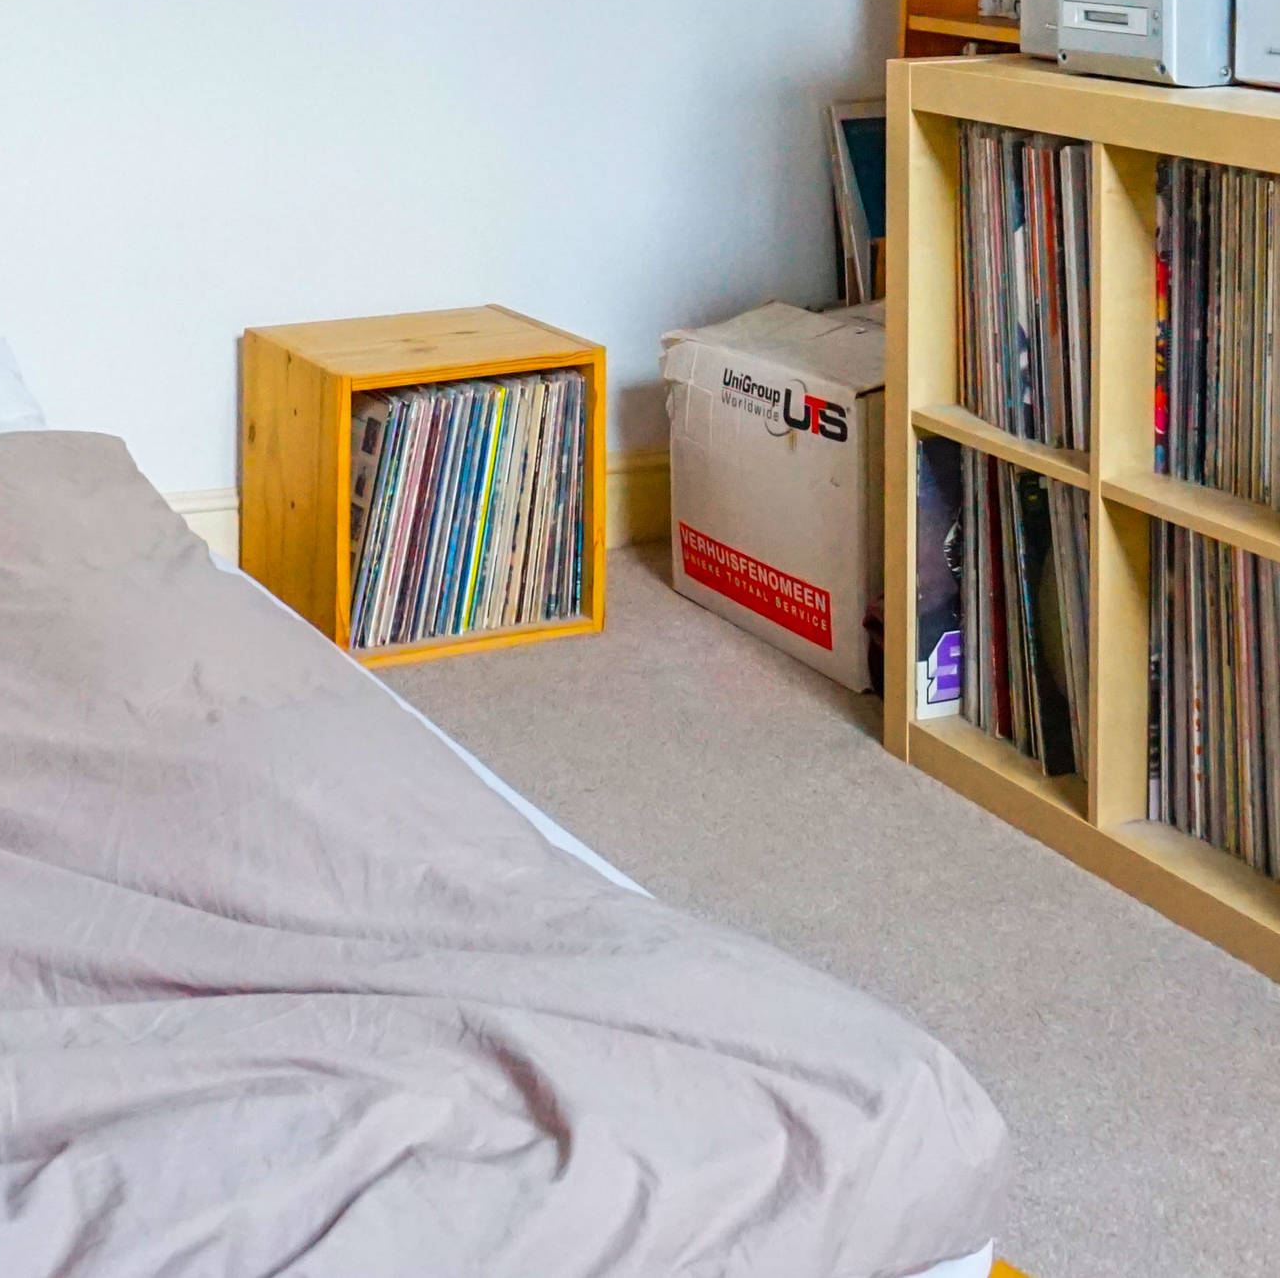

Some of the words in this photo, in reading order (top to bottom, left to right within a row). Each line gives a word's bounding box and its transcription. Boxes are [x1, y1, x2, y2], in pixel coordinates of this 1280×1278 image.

[721, 389, 780, 422] Worldwide
[722, 367, 781, 408] UniGroup
[783, 386, 848, 443] UTS
[680, 527, 827, 613] VERHUISFENOMEEN
[726, 571, 770, 603] TOTAAL
[775, 595, 828, 631] SERVICE
